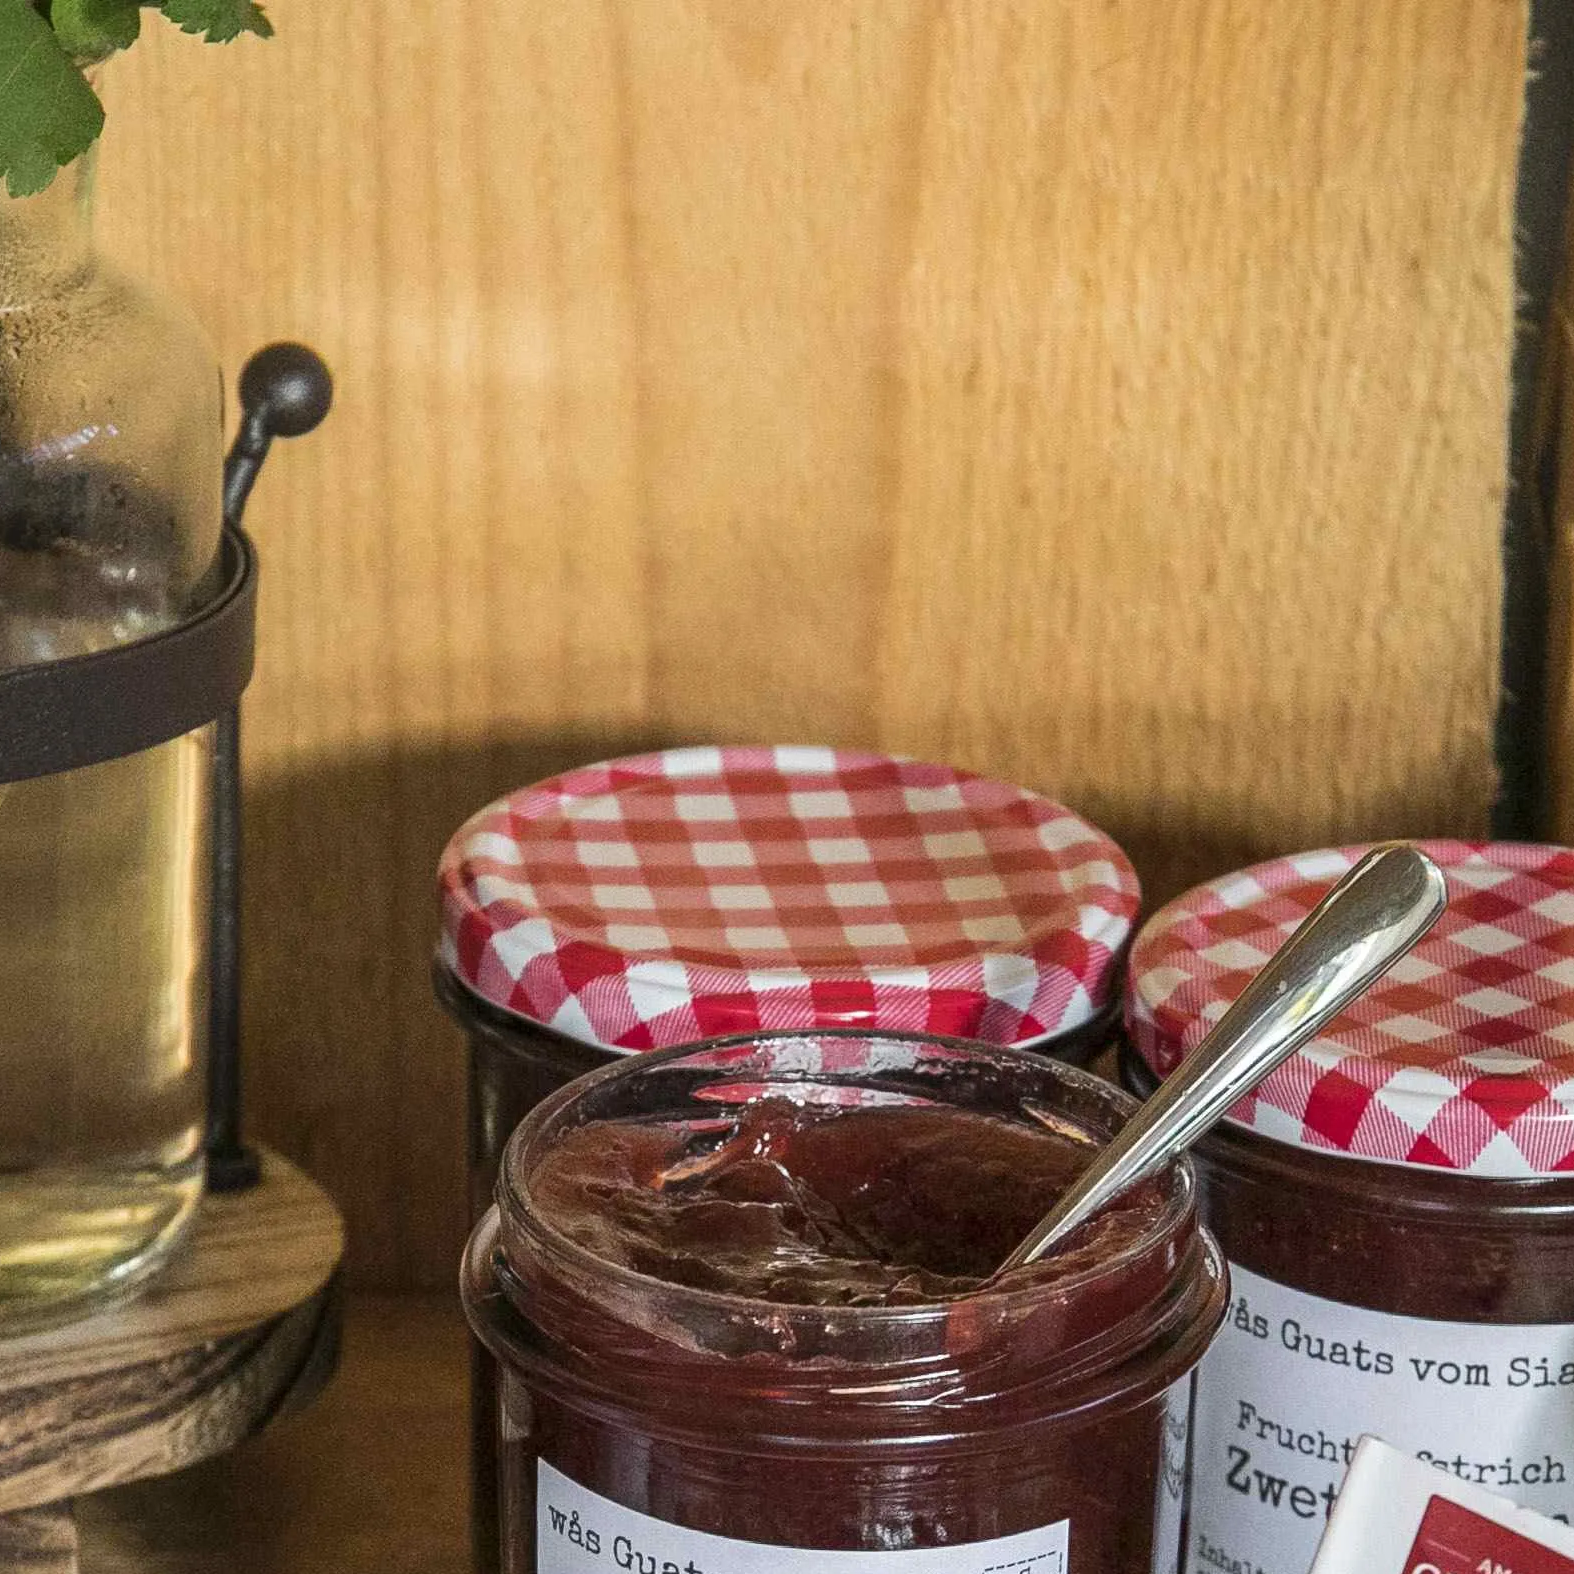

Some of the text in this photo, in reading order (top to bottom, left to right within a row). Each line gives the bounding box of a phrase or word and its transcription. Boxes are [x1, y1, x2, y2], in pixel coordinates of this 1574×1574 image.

[1226, 1298, 1269, 1340] ås
[1281, 1319, 1395, 1375] Guats
[1409, 1357, 1490, 1386] vom
[548, 1504, 601, 1555] wås
